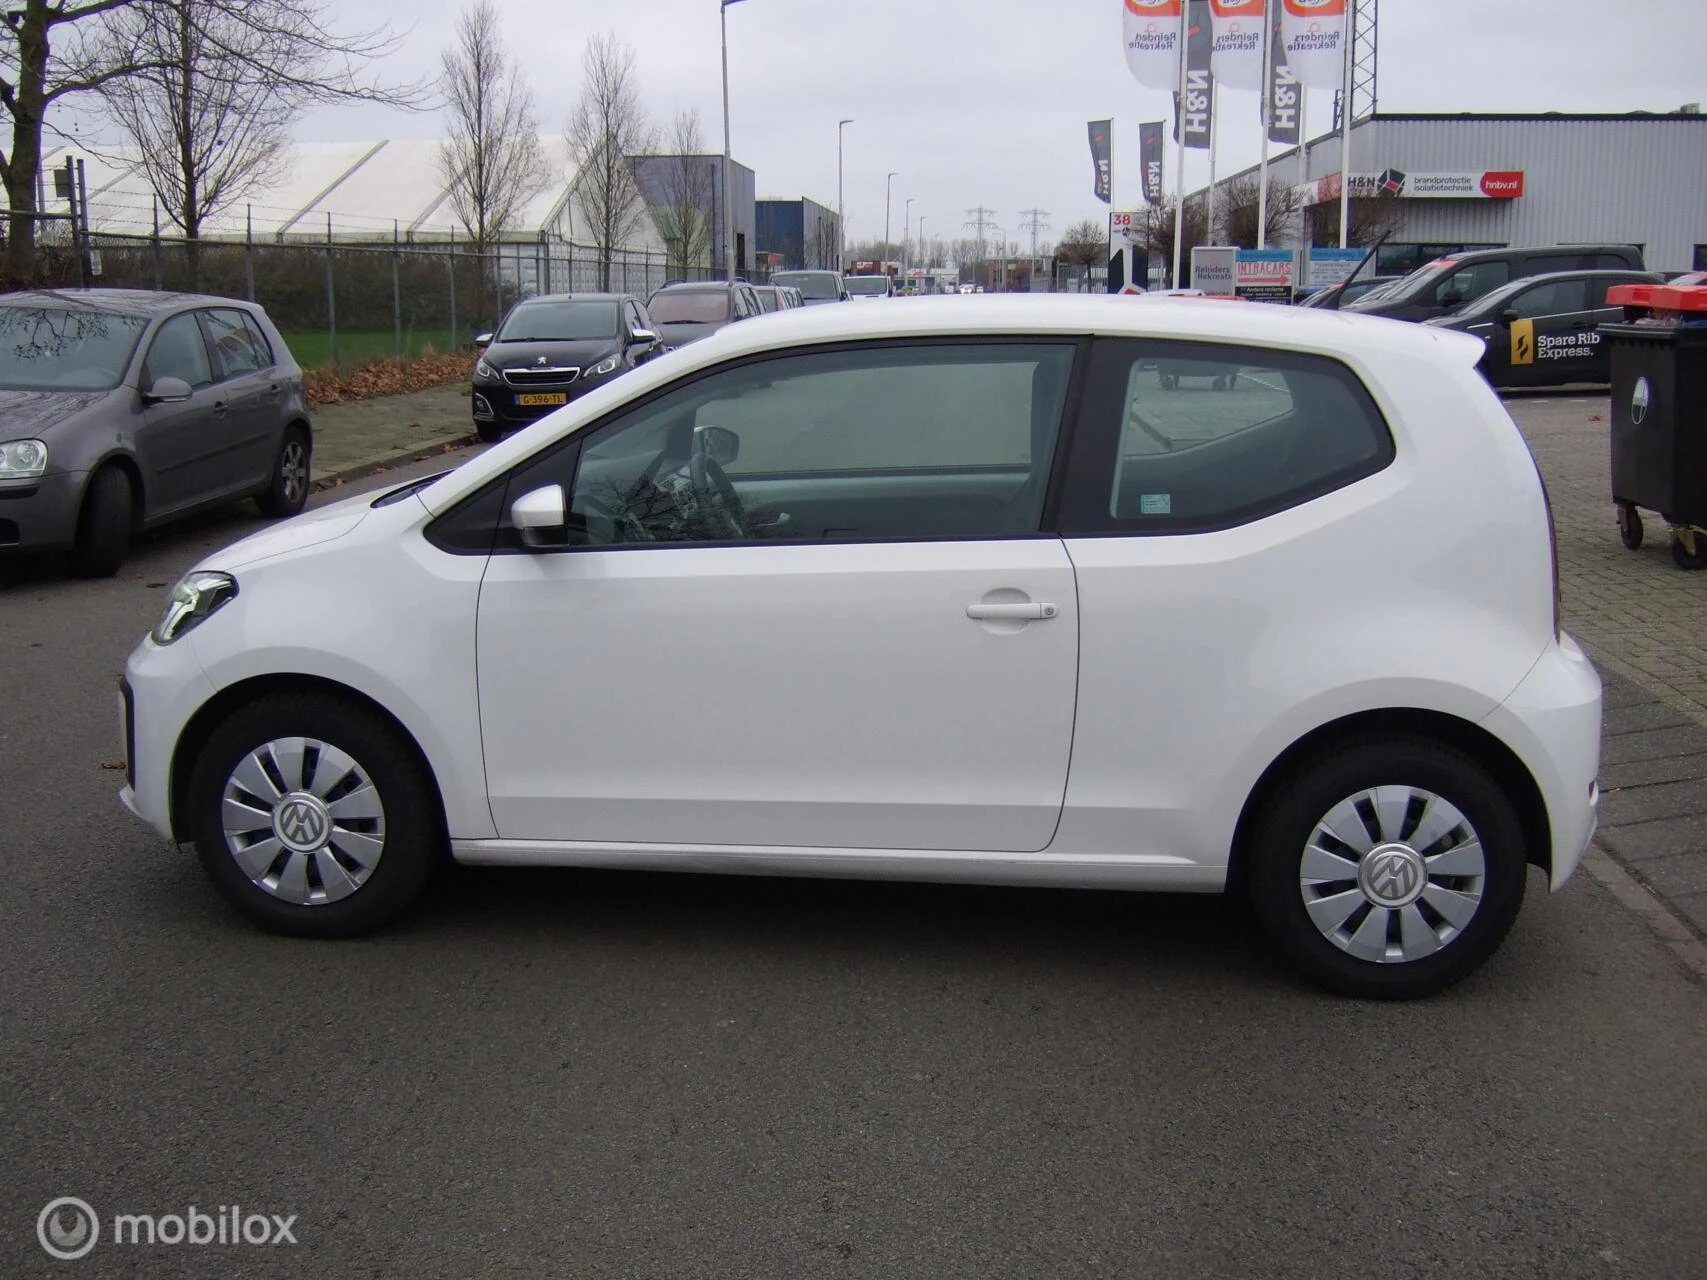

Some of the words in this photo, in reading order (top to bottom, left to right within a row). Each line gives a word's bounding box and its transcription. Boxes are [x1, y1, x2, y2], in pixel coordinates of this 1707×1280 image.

[1347, 176, 1376, 188] H&N
[1414, 176, 1471, 185] brandprotectie
[1485, 180, 1518, 190] hnbv.nl
[1413, 184, 1473, 192] isolatietechniek
[1113, 214, 1131, 225] 38
[1538, 335, 1576, 348] Spare
[1578, 332, 1600, 345] Rib
[1538, 346, 1594, 359] Express.
[523, 394, 563, 404] G-396-TL
